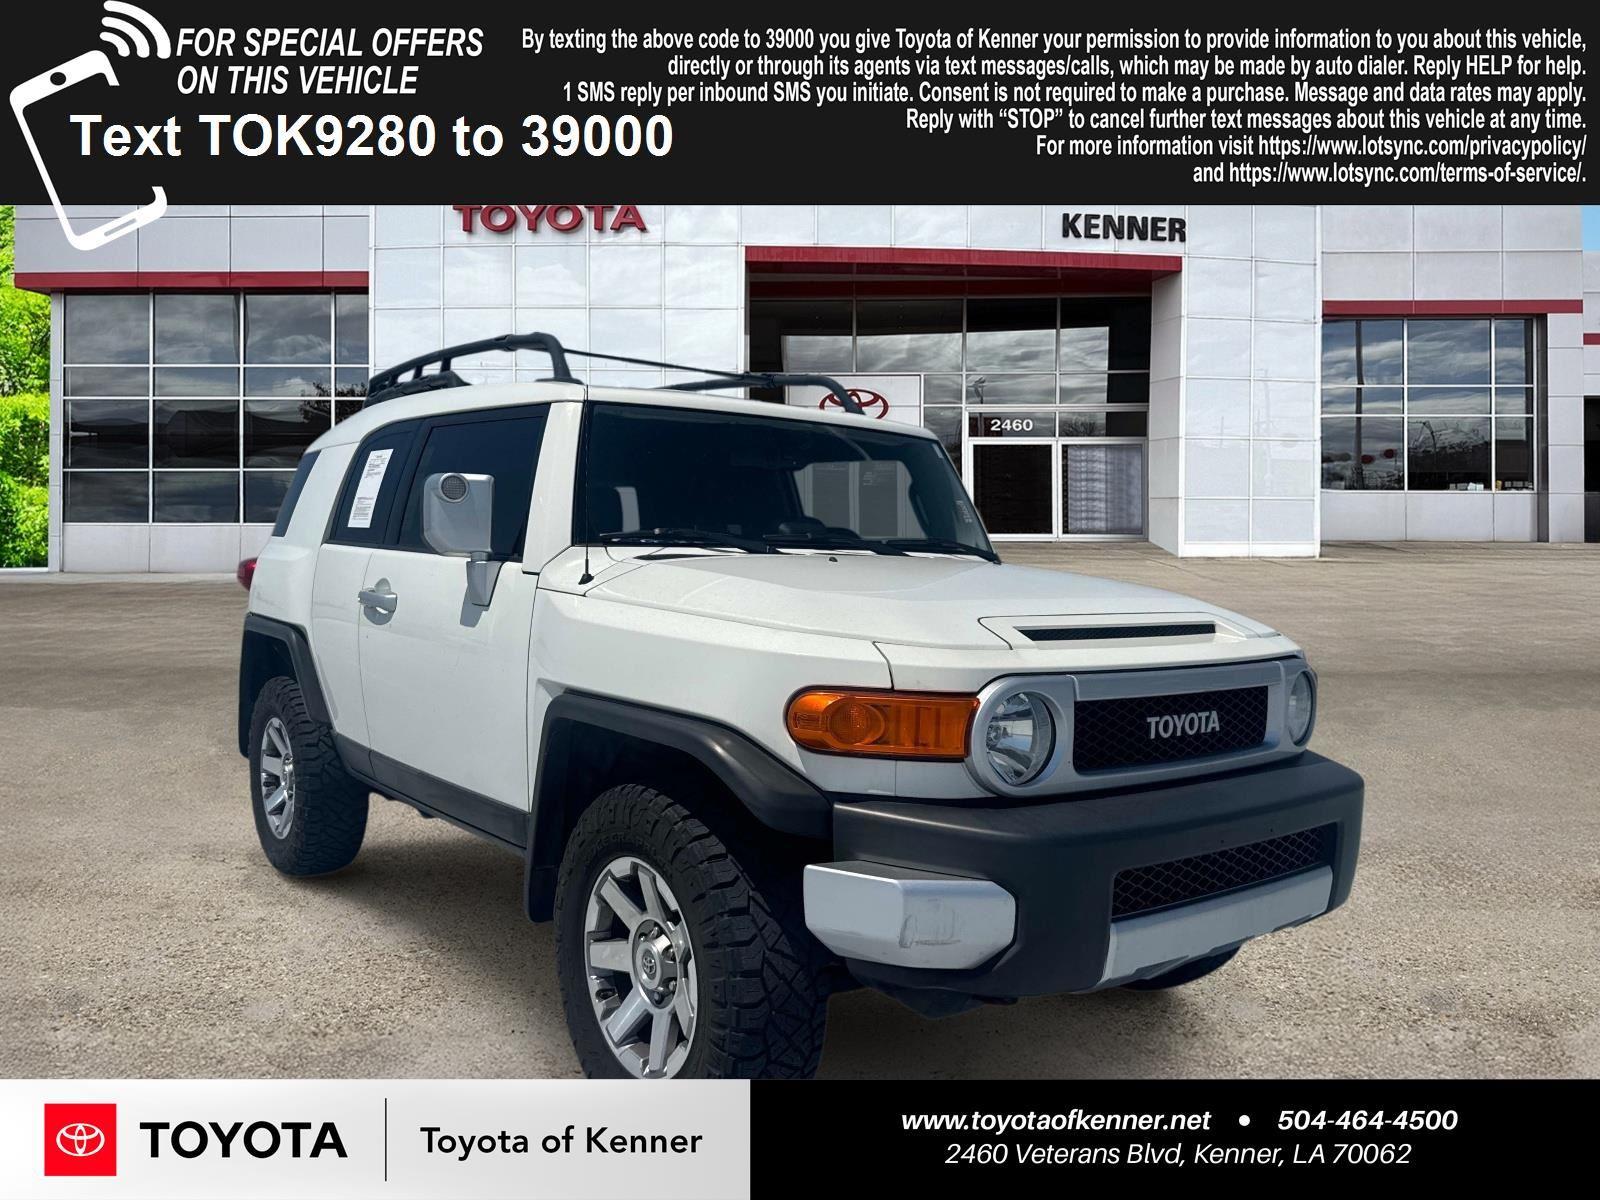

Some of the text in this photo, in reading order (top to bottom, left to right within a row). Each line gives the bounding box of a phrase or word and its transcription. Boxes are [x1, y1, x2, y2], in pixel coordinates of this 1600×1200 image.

[452, 205, 647, 232] TOYOTA
[1062, 213, 1187, 242] KENNER
[990, 418, 1033, 431] 2460
[1146, 710, 1220, 739] TOYOTA
